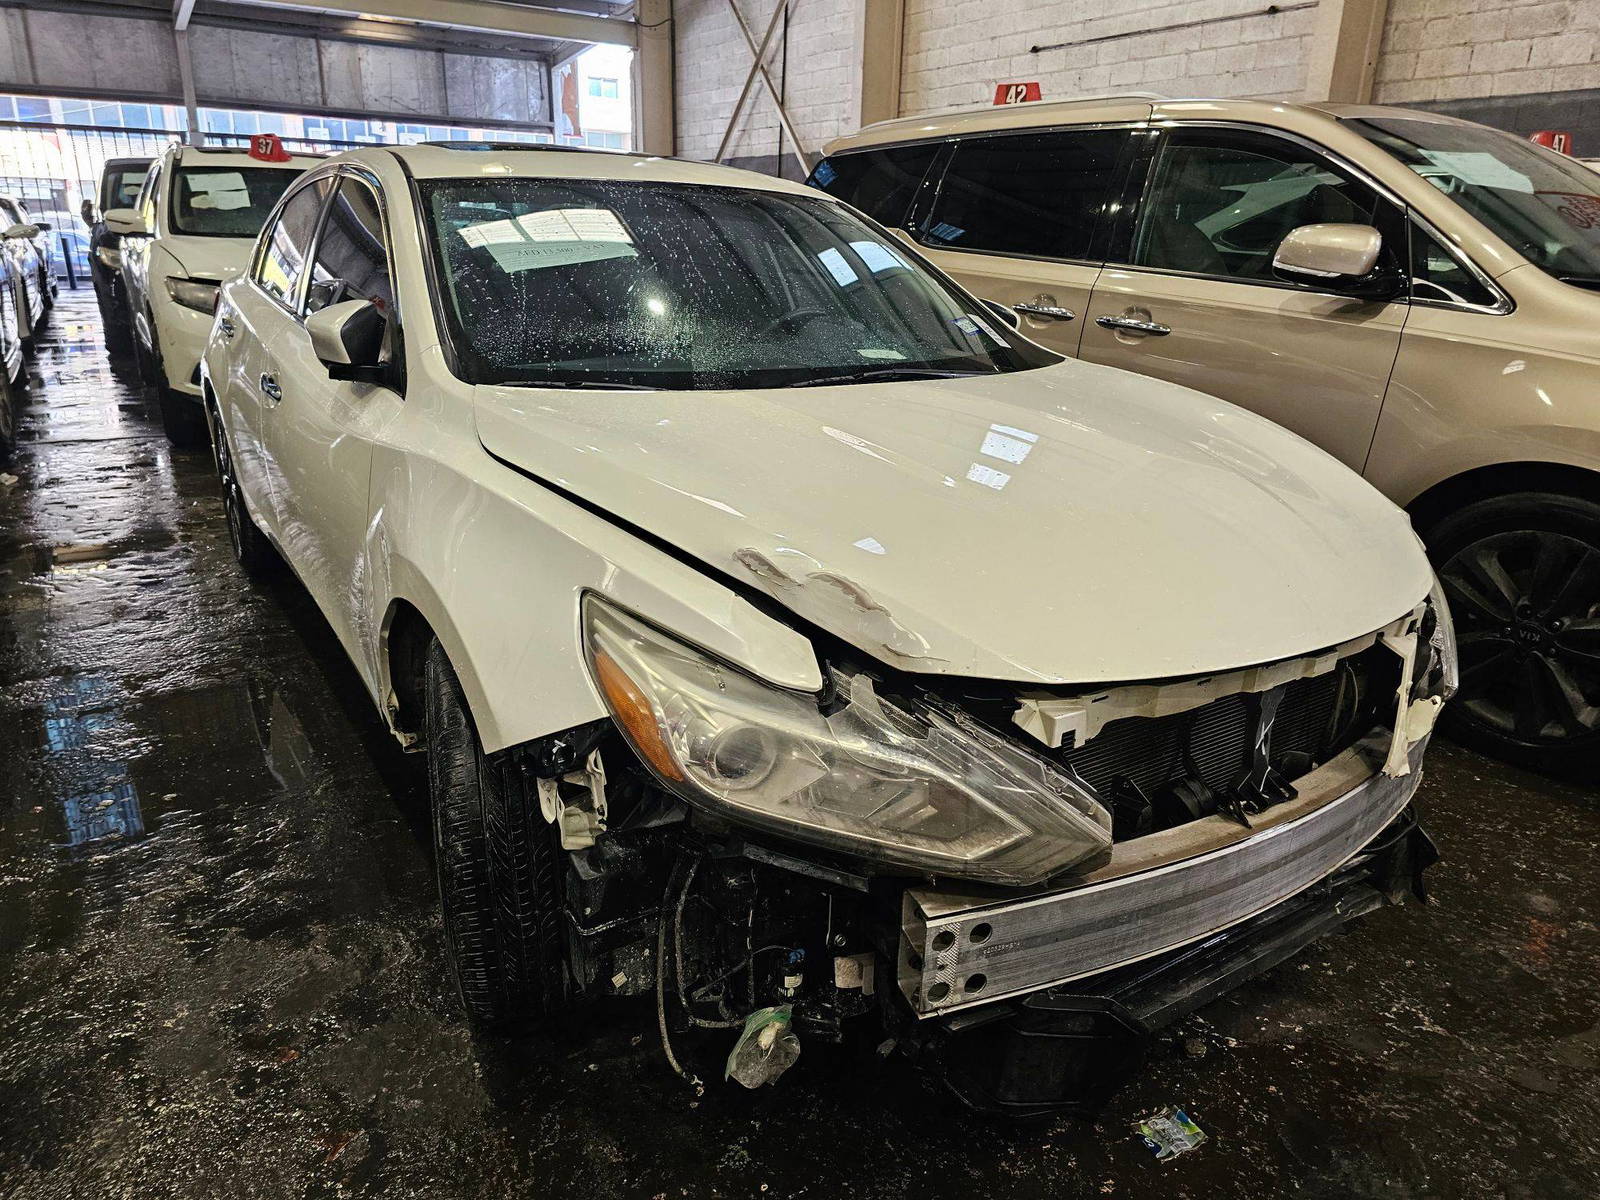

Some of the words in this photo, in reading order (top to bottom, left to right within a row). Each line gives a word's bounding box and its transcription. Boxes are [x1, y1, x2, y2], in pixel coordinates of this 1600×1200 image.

[1006, 85, 1027, 104] 42
[258, 138, 273, 154] 37
[1553, 134, 1566, 153] 47
